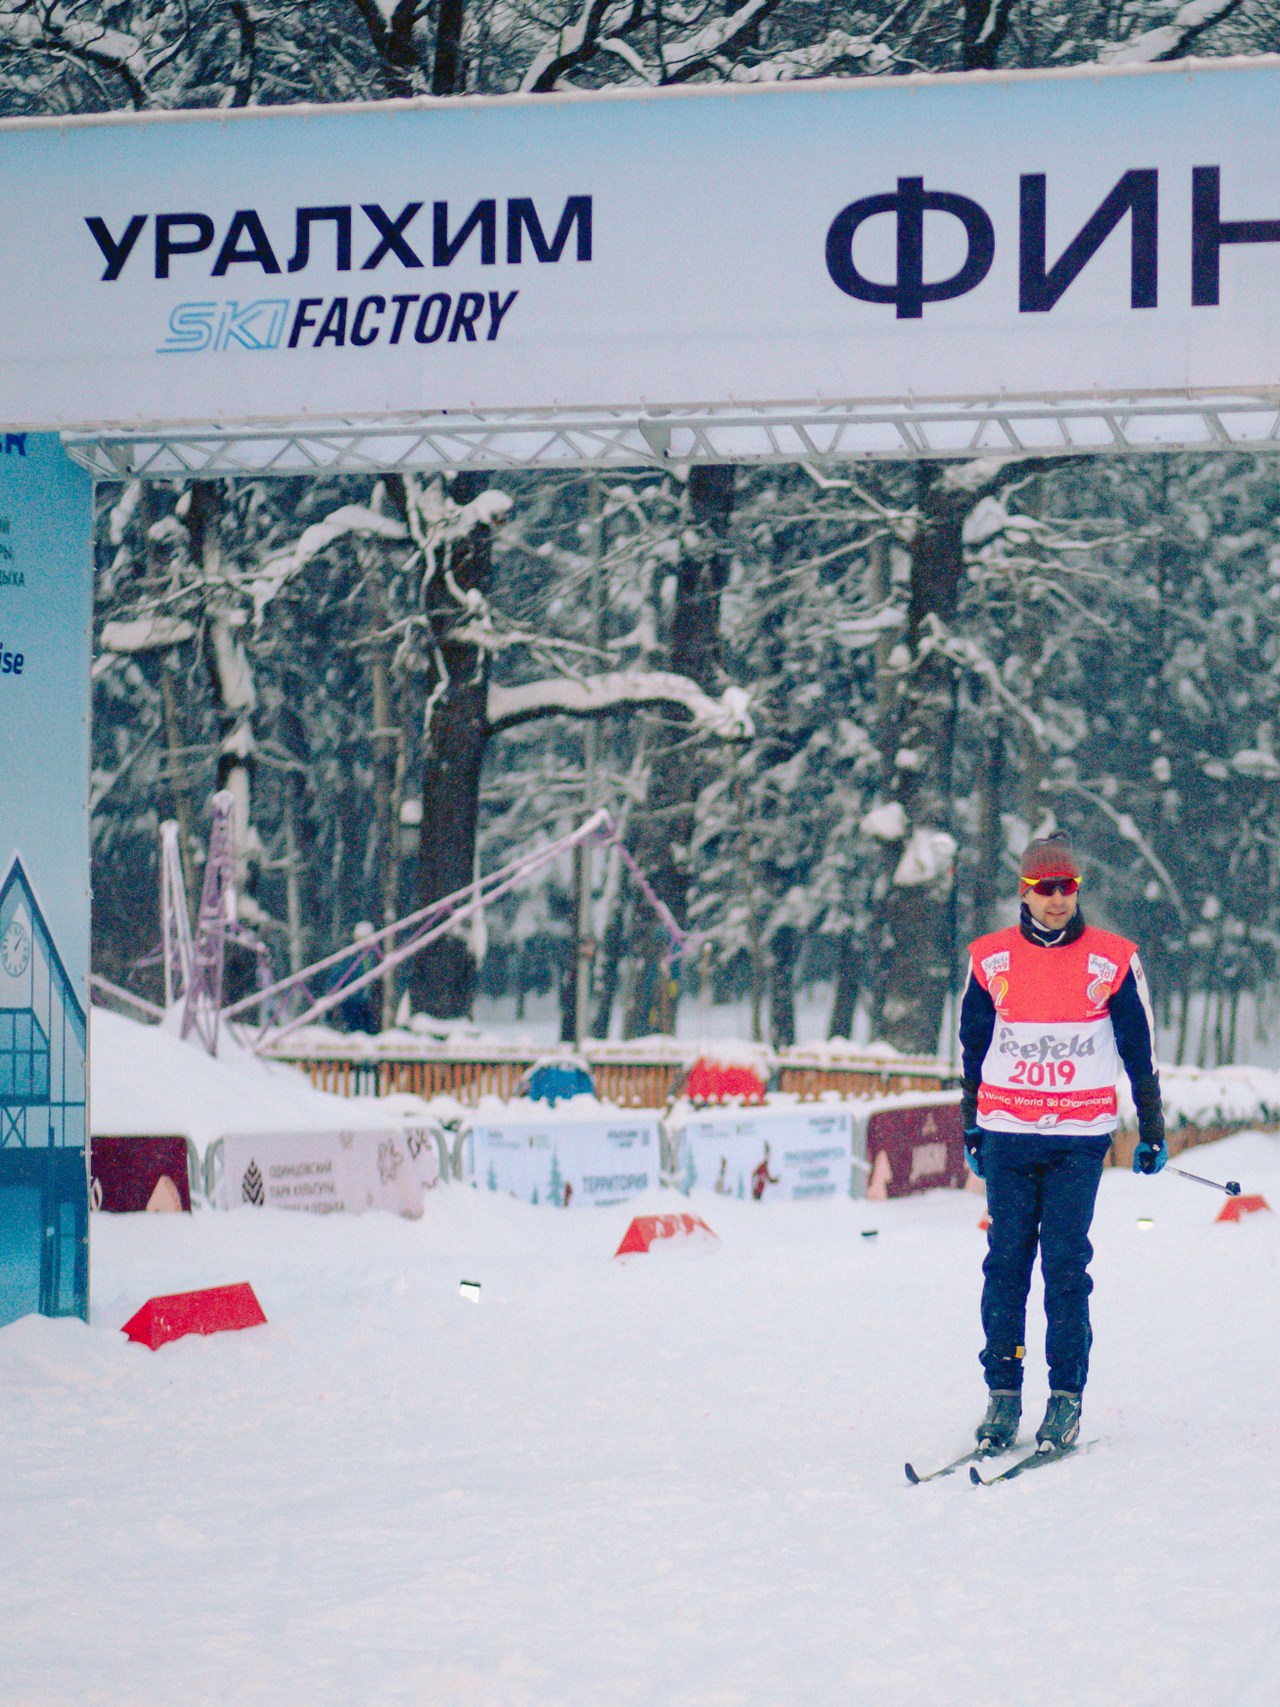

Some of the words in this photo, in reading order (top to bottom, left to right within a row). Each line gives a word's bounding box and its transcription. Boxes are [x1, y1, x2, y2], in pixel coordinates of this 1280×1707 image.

[84, 194, 593, 281] УРАЛХИМ
[999, 1026, 1096, 1064] Seefeld
[1008, 1059, 1076, 1087] 2019
[1014, 1097, 1043, 1107] World
[1046, 1097, 1058, 1107] Ski
